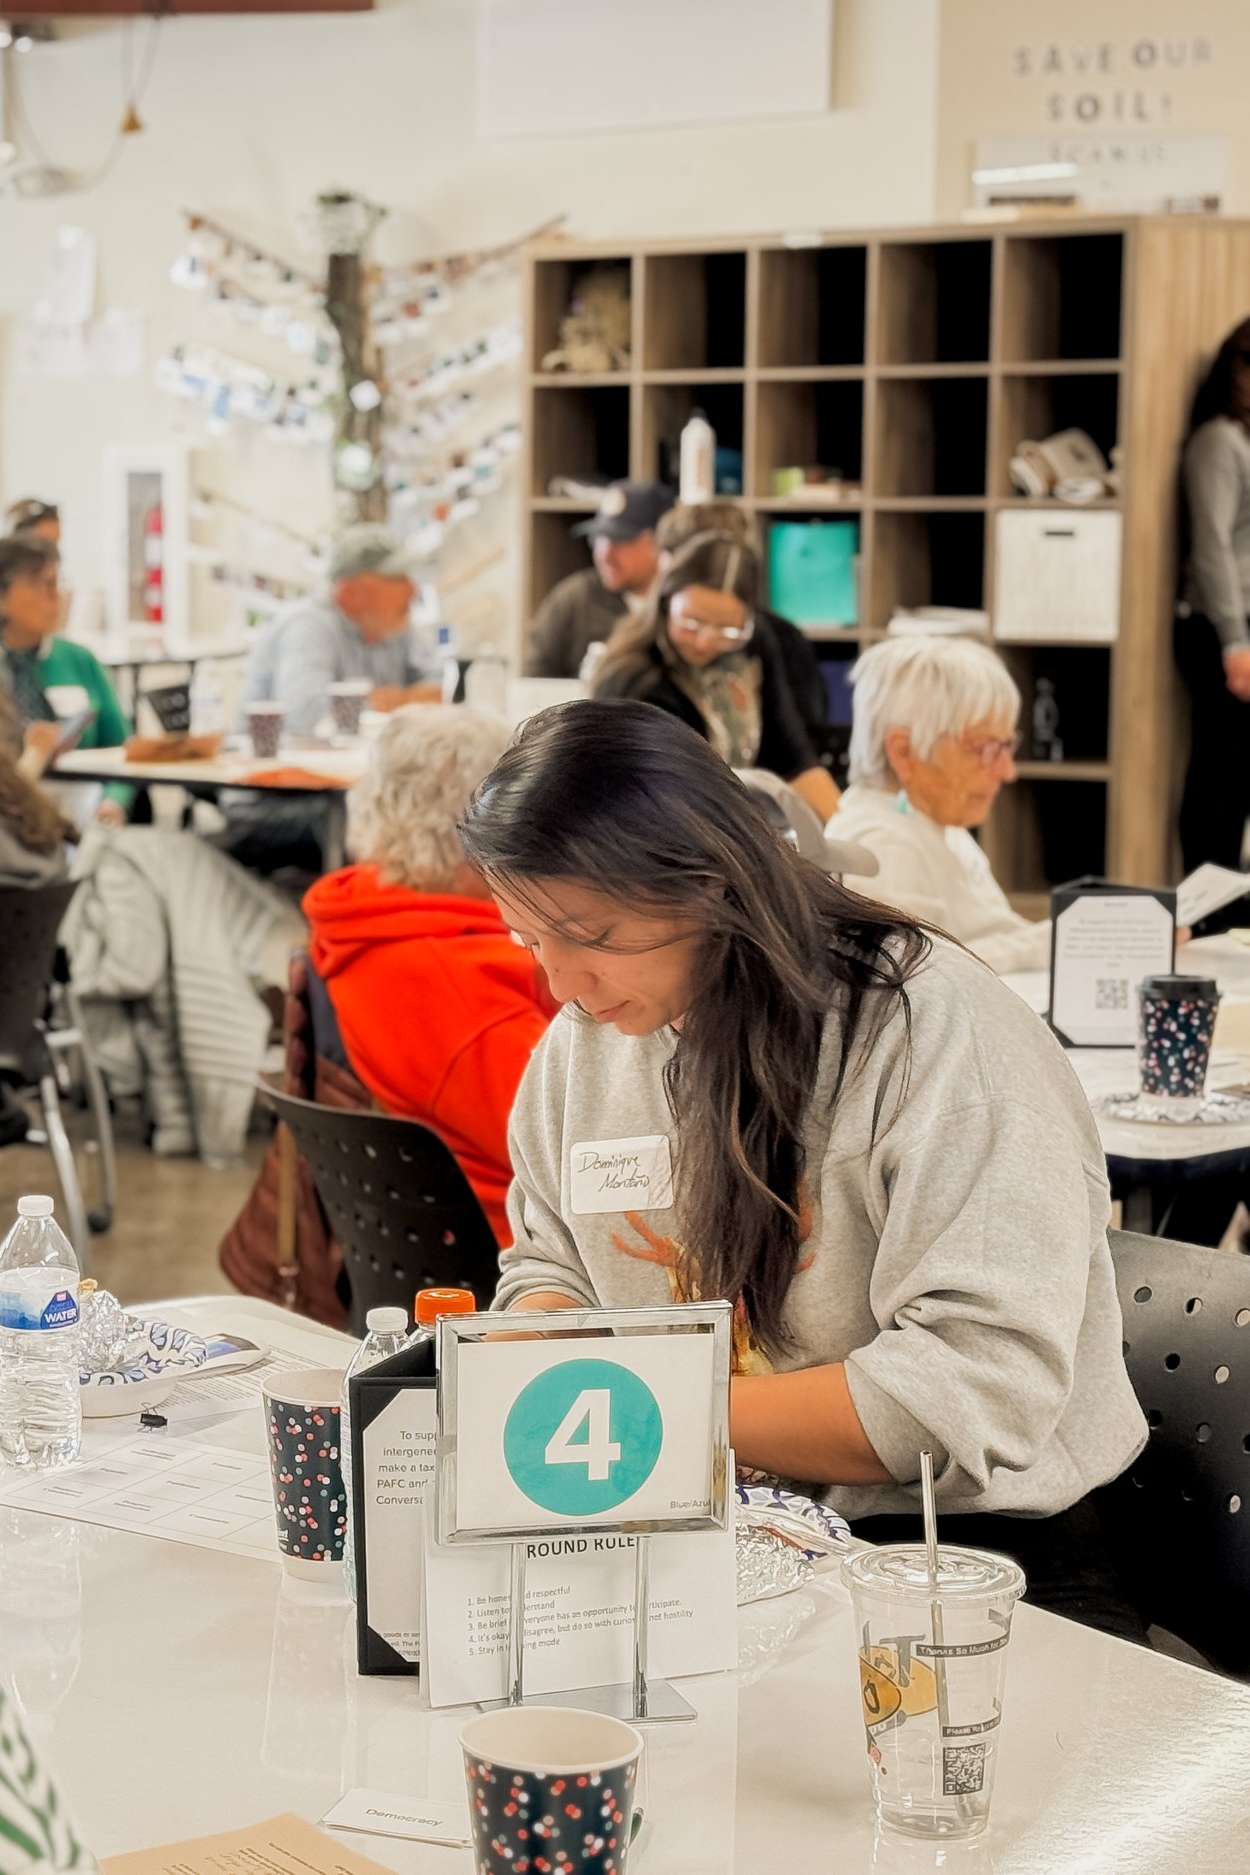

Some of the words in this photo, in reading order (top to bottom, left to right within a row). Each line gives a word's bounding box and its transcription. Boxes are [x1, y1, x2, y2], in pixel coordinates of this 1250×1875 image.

[1133, 38, 1213, 68] OUR
[578, 1151, 641, 1175] Dominique
[44, 1308, 78, 1324] WATER
[400, 1430, 412, 1441] To
[545, 1388, 621, 1480] 4
[378, 1464, 408, 1473] make
[409, 1465, 417, 1473] a
[419, 1463, 436, 1473] tax
[376, 1479, 406, 1489] PAFC
[526, 1538, 588, 1559] ROUND
[593, 1536, 635, 1552] RULE
[533, 1586, 571, 1600] respectful
[476, 1608, 500, 1617] Listen
[477, 1621, 488, 1631] Be
[489, 1618, 507, 1629] brief
[582, 1605, 628, 1618] opportunity
[477, 1633, 490, 1643] It's
[491, 1631, 511, 1642] okay
[477, 1646, 495, 1656] Stay
[365, 1808, 444, 1827] Democracy
